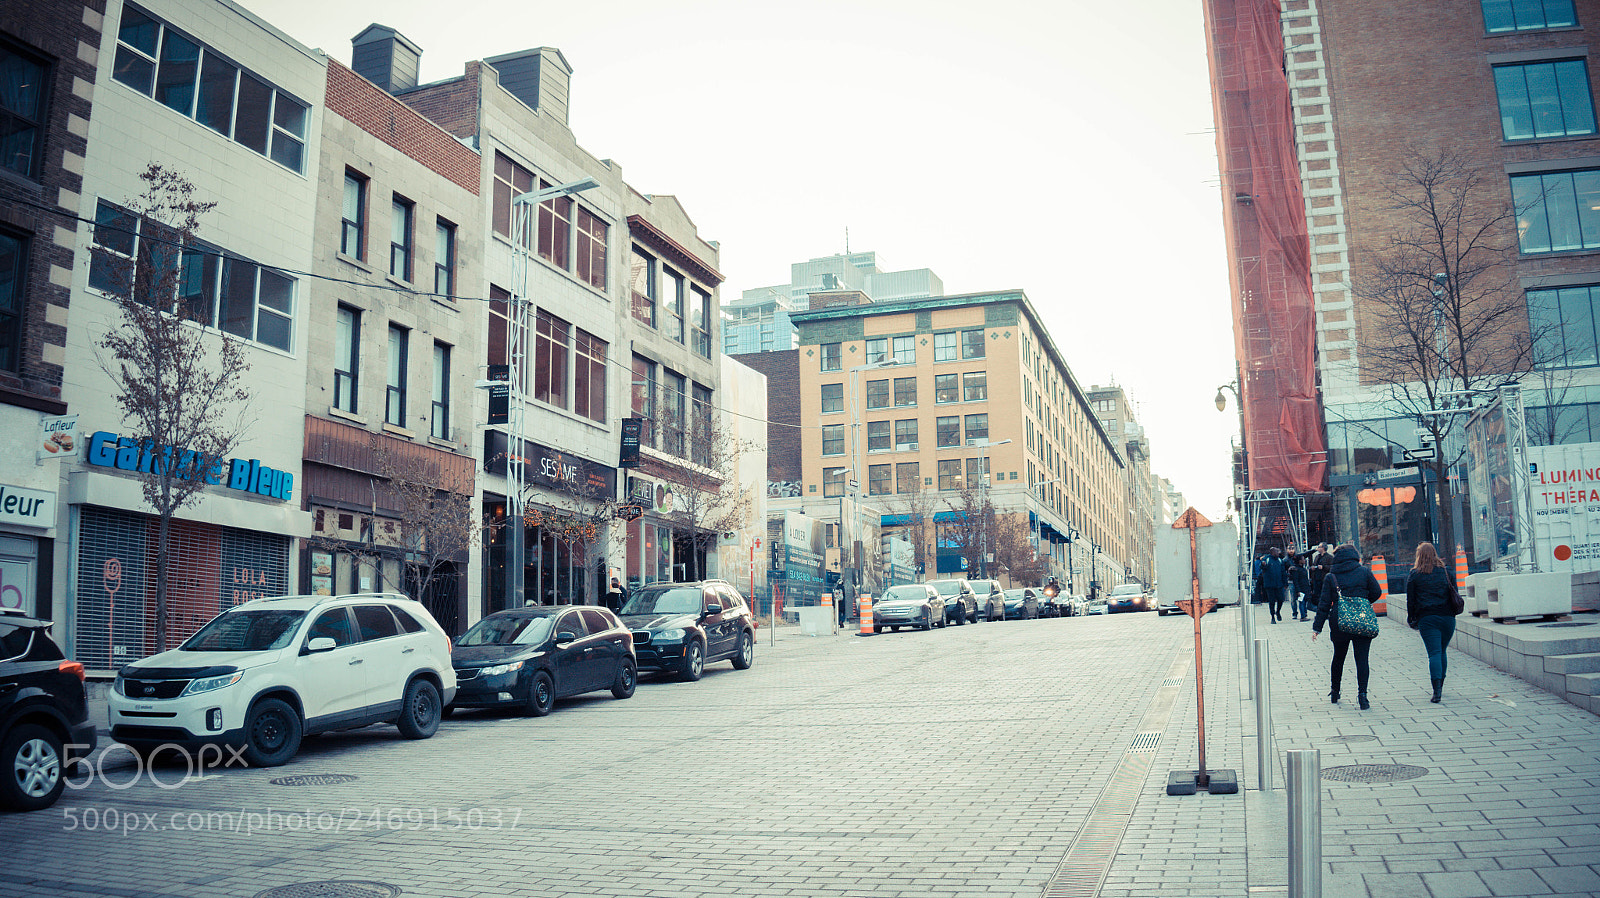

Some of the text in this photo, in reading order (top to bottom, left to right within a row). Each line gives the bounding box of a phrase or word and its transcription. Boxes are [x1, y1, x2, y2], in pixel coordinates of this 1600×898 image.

[44, 420, 76, 432] Lafleur
[227, 457, 294, 500] Bleue
[541, 457, 577, 483] SESAME
[1380, 470, 1406, 478] Balmoral
[233, 567, 266, 585] LOLA
